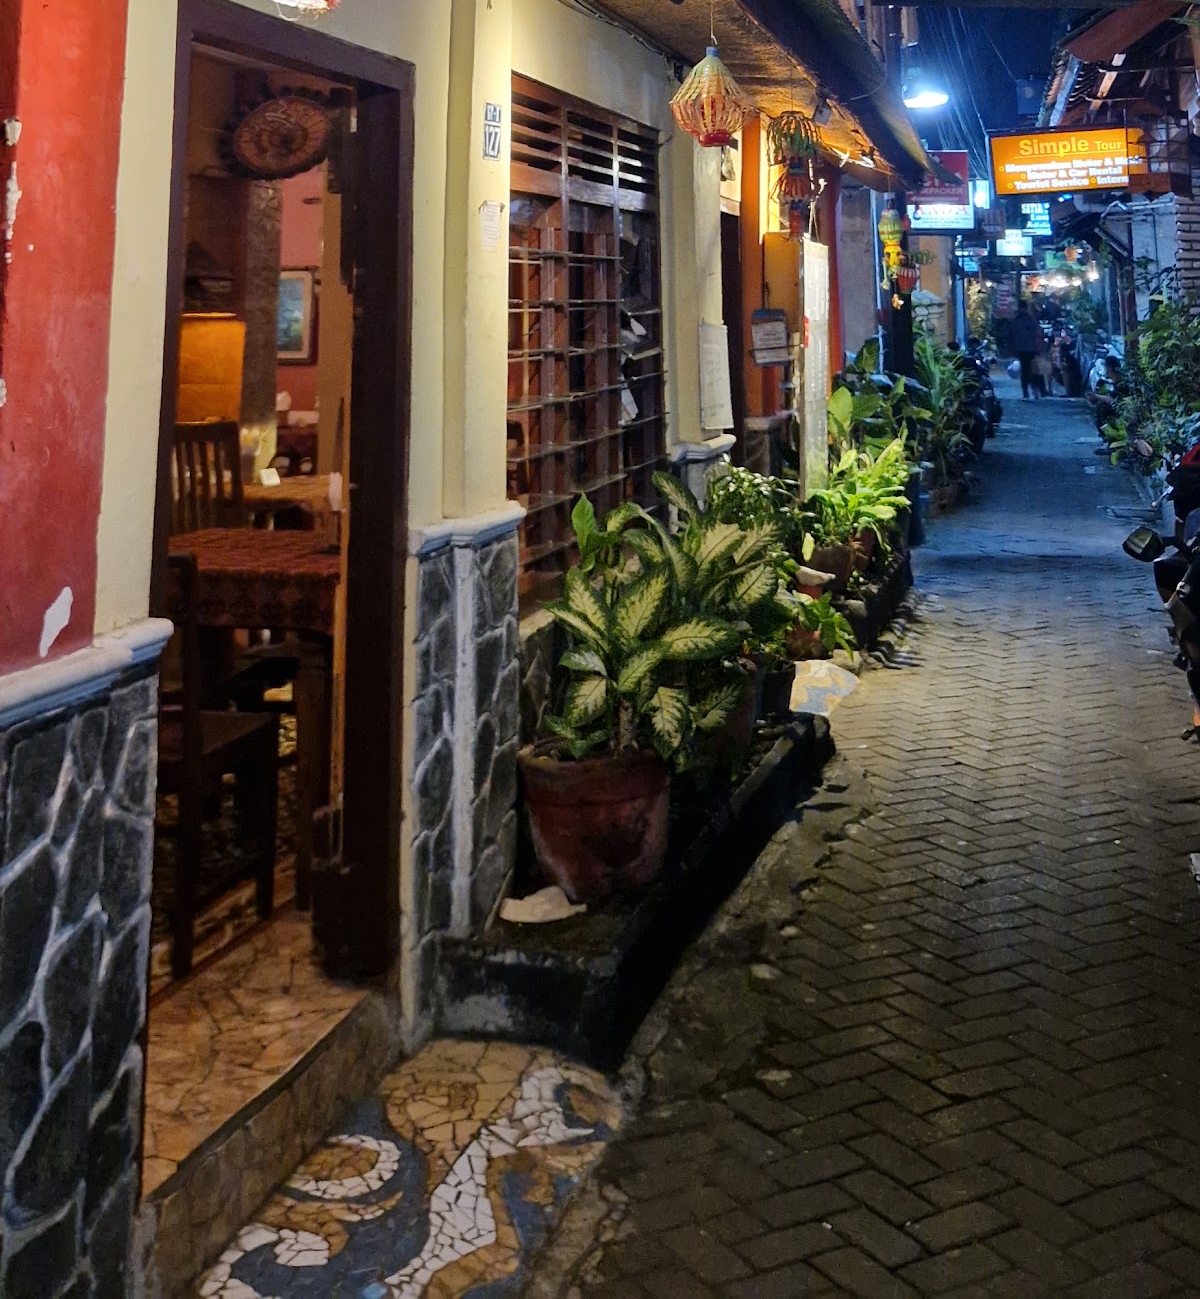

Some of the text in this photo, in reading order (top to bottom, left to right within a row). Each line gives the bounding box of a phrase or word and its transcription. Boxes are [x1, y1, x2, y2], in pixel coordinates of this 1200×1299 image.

[485, 125, 500, 156] 127
[1019, 137, 1122, 157] Simple Tour
[1072, 159, 1103, 169] Motor
[1104, 157, 1113, 166] &
[1027, 166, 1122, 180] Motor & Car Rental
[1014, 179, 1050, 190] Tourist
[1051, 177, 1089, 187] Service
